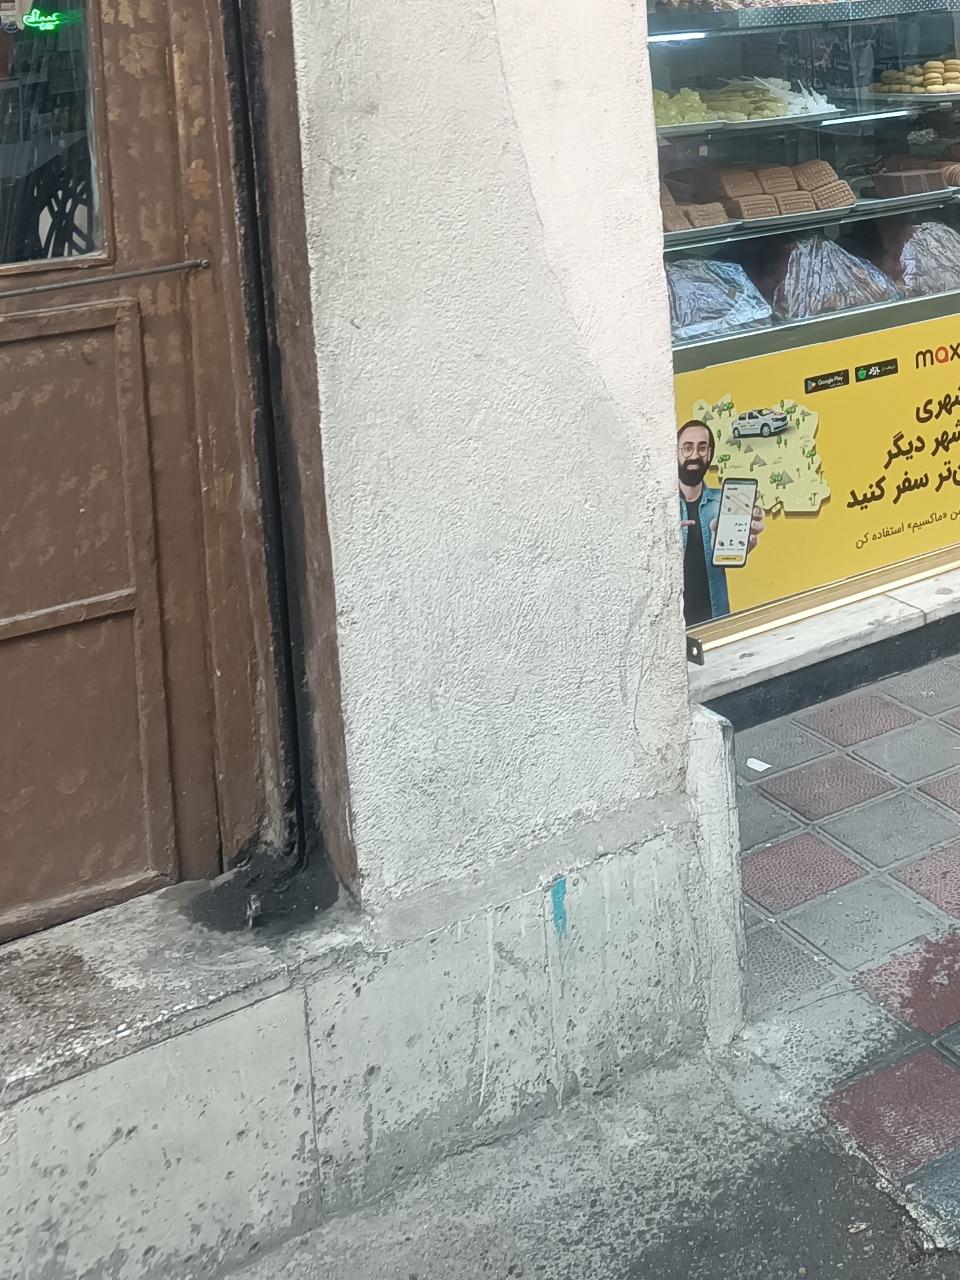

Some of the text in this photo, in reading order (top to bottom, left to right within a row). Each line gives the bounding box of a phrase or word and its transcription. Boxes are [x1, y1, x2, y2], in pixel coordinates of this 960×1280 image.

[817, 377, 834, 385] Google
[884, 431, 926, 470] دیگر
[846, 475, 887, 511] کنید
[892, 470, 929, 504] سفر
[855, 532, 869, 549] کن
[872, 522, 905, 541] استفاده
